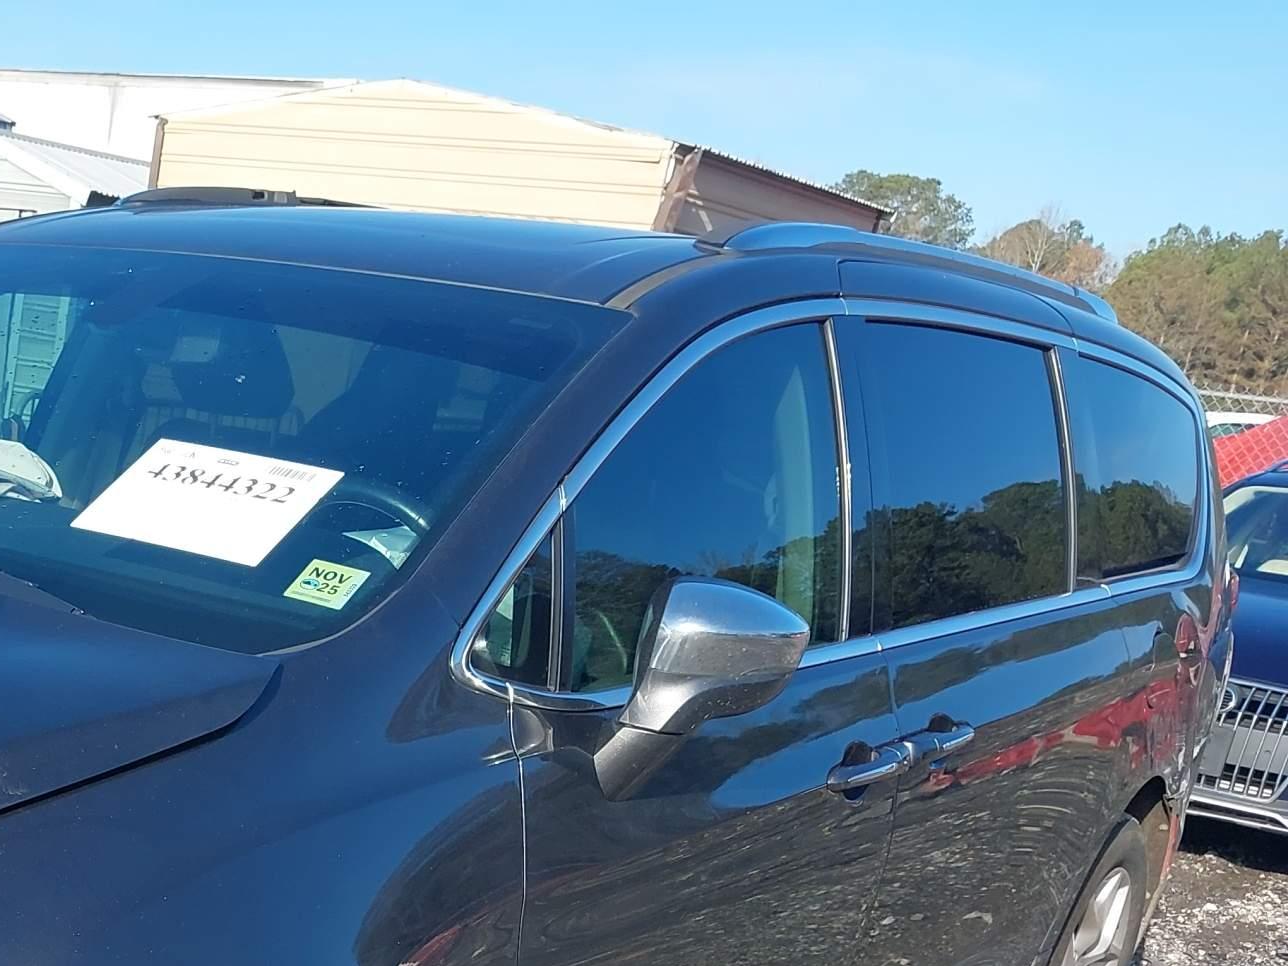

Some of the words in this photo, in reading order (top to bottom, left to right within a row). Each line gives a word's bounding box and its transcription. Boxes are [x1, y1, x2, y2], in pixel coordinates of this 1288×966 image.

[147, 463, 296, 504] 43844322
[308, 566, 353, 585] NOV
[316, 582, 341, 595] 25
